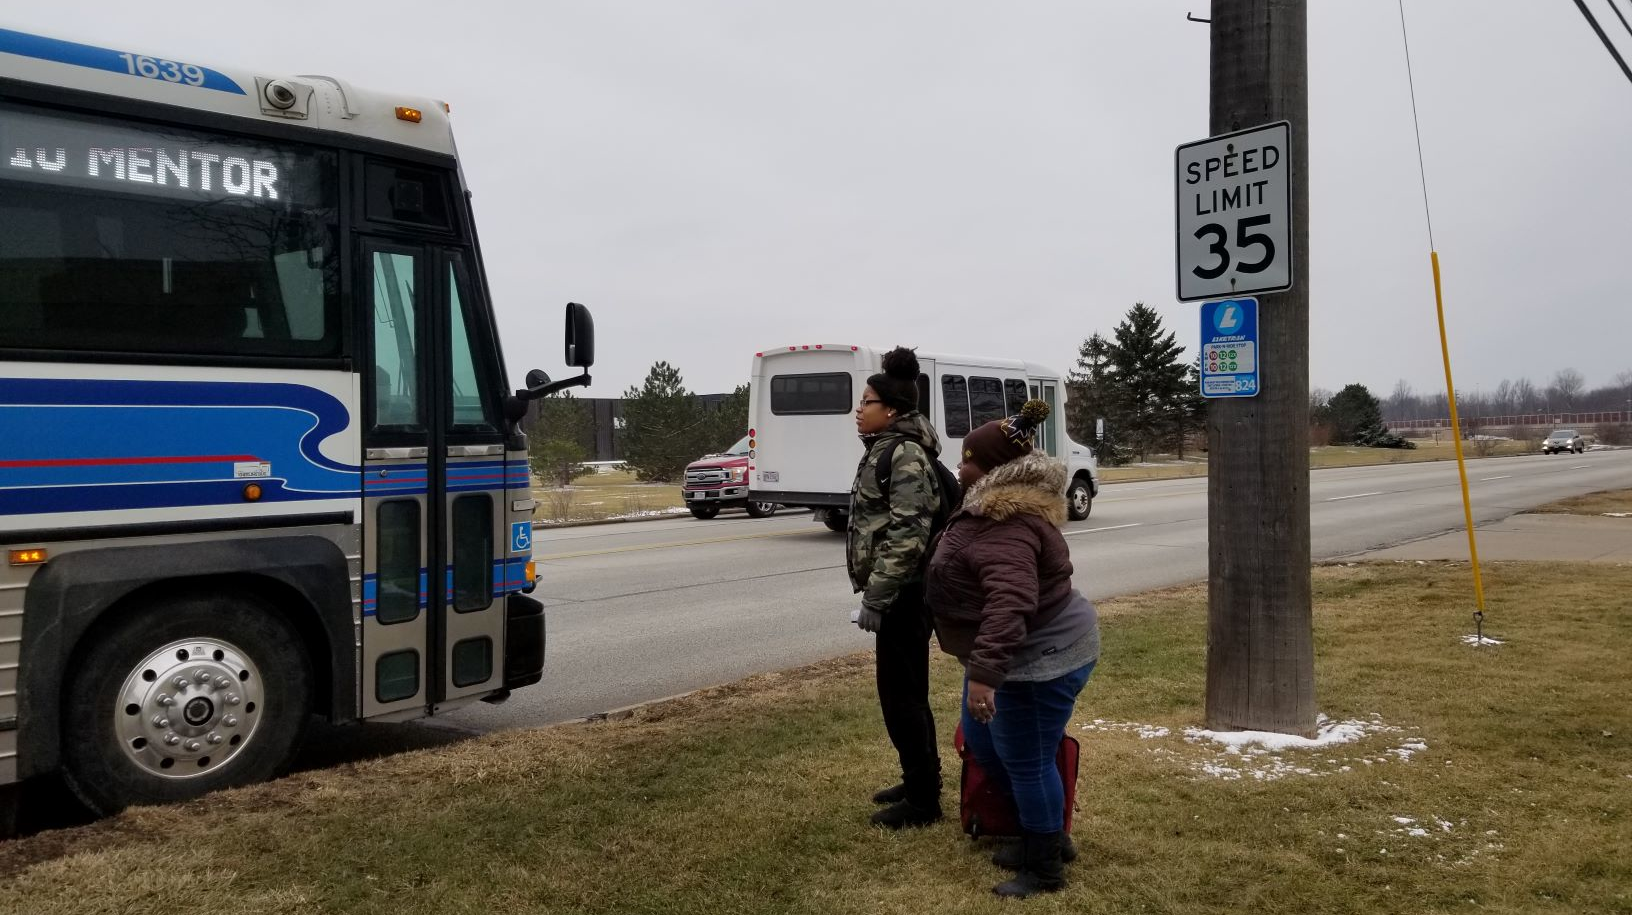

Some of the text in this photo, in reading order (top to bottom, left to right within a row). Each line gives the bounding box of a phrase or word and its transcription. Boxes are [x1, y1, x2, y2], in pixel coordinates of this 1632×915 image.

[119, 52, 205, 87] 1639
[88, 147, 280, 200] MENTOR
[1186, 145, 1280, 185] SPEED
[1196, 180, 1269, 216] LIMIT
[1192, 213, 1276, 280] 35
[1235, 380, 1256, 391] 824
